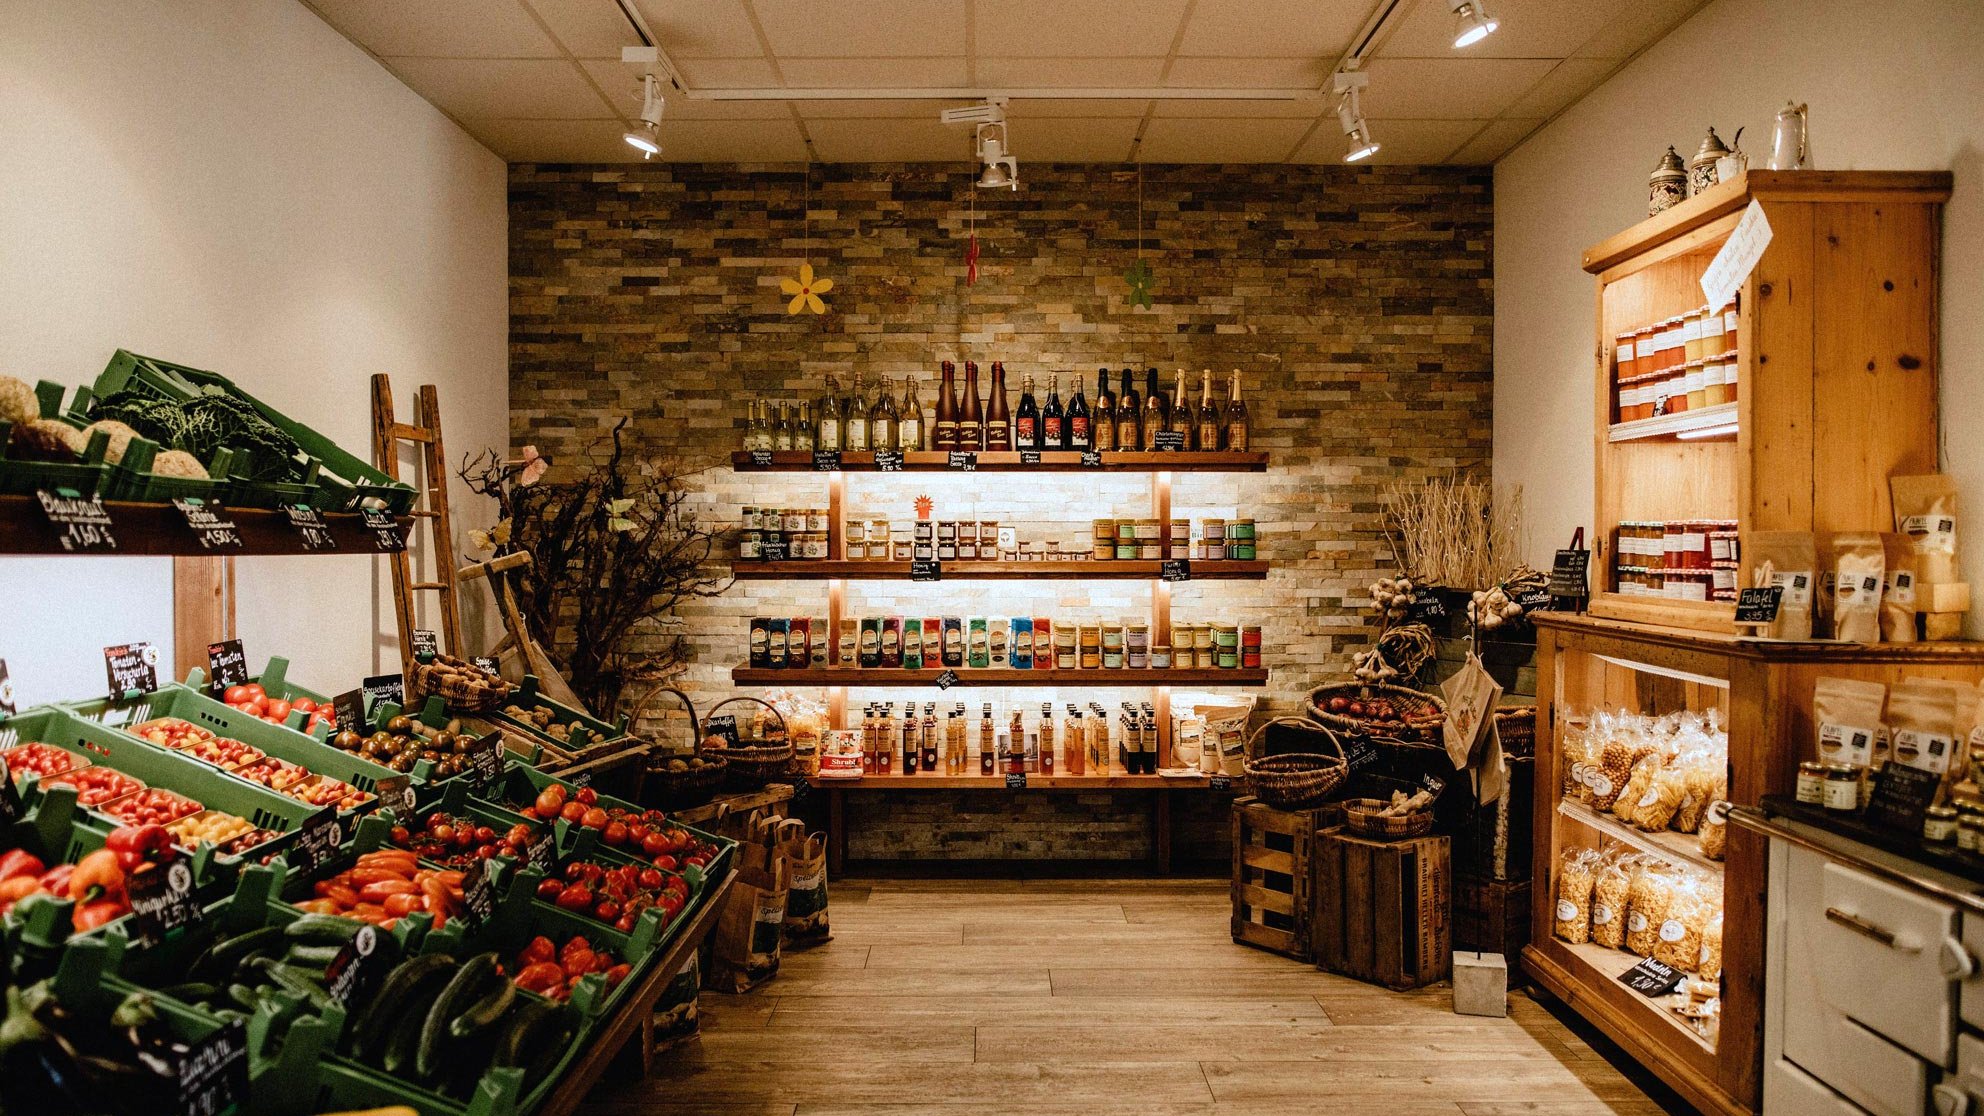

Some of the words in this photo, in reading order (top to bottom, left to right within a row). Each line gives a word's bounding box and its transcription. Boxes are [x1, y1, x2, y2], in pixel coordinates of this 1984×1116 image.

[913, 562, 928, 570] Honig
[1742, 589, 1774, 606] Falafel
[218, 650, 243, 667] Tomaten
[1640, 956, 1672, 977] Nudeln
